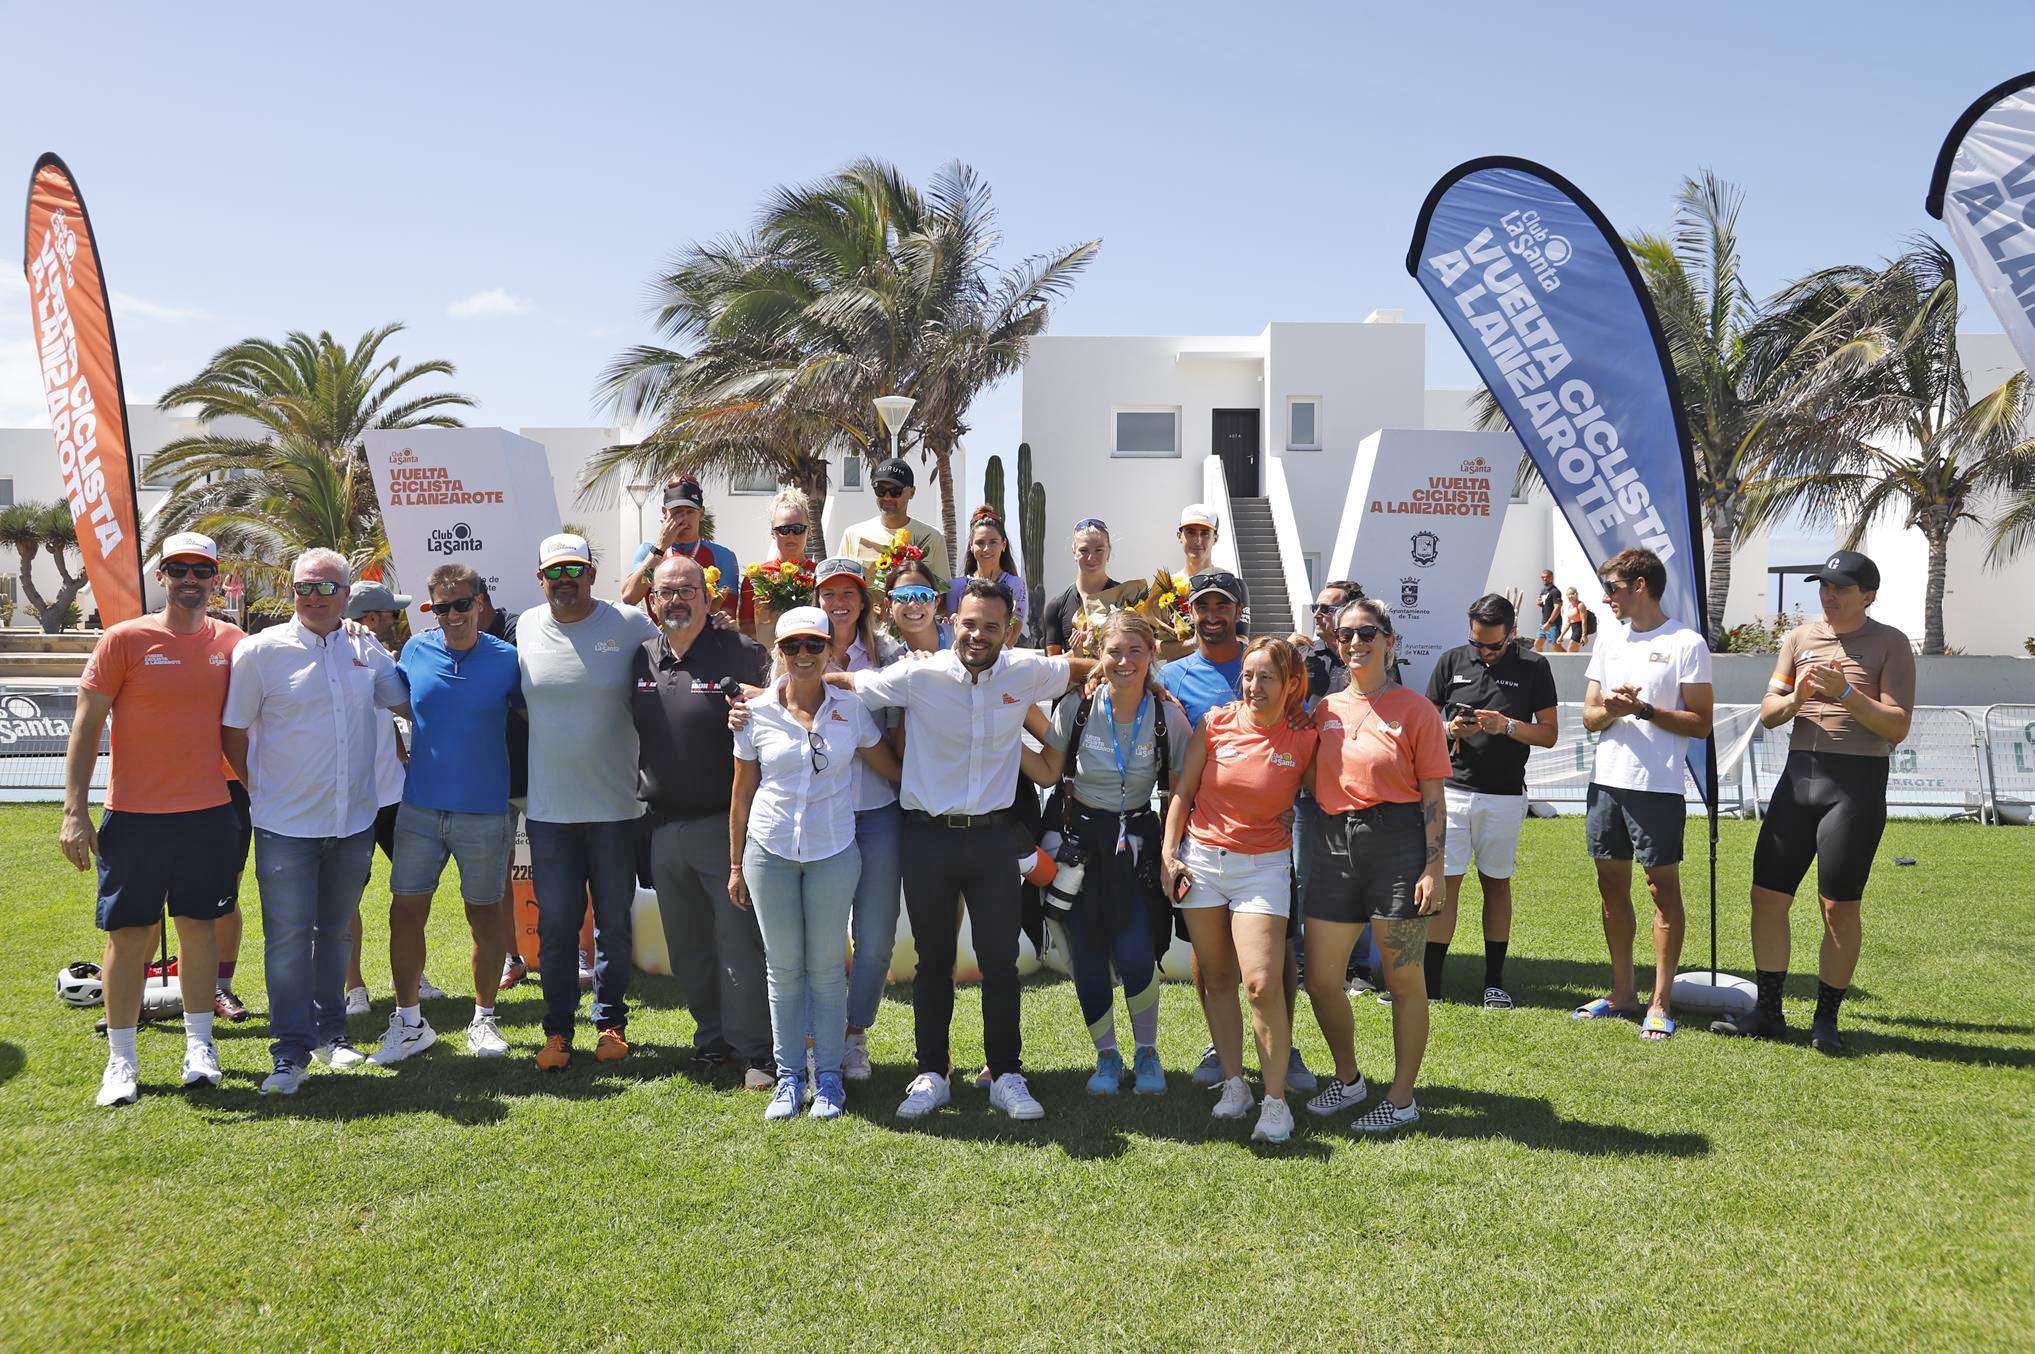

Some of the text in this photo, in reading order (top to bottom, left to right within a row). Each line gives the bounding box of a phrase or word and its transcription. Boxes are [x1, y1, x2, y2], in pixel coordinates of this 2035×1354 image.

[1522, 210, 1549, 241] Club
[41, 229, 124, 560] VUELTA CICLISTA
[1427, 249, 1626, 537] A LANZAROTE
[1465, 226, 1676, 564] VUELTA CICLISTA
[38, 286, 88, 525] LANZAROTE
[390, 467, 449, 480] VUELTA
[390, 479, 464, 493] CICLISTA
[1429, 477, 1490, 490] VUELTA
[390, 491, 504, 506] A LANZAROTE
[1412, 489, 1490, 503] CICLISTA
[1370, 501, 1490, 517] A LANZAROTE
[431, 529, 453, 540] Club
[489, 575, 499, 583] de
[1496, 679, 1519, 688] AURUM
